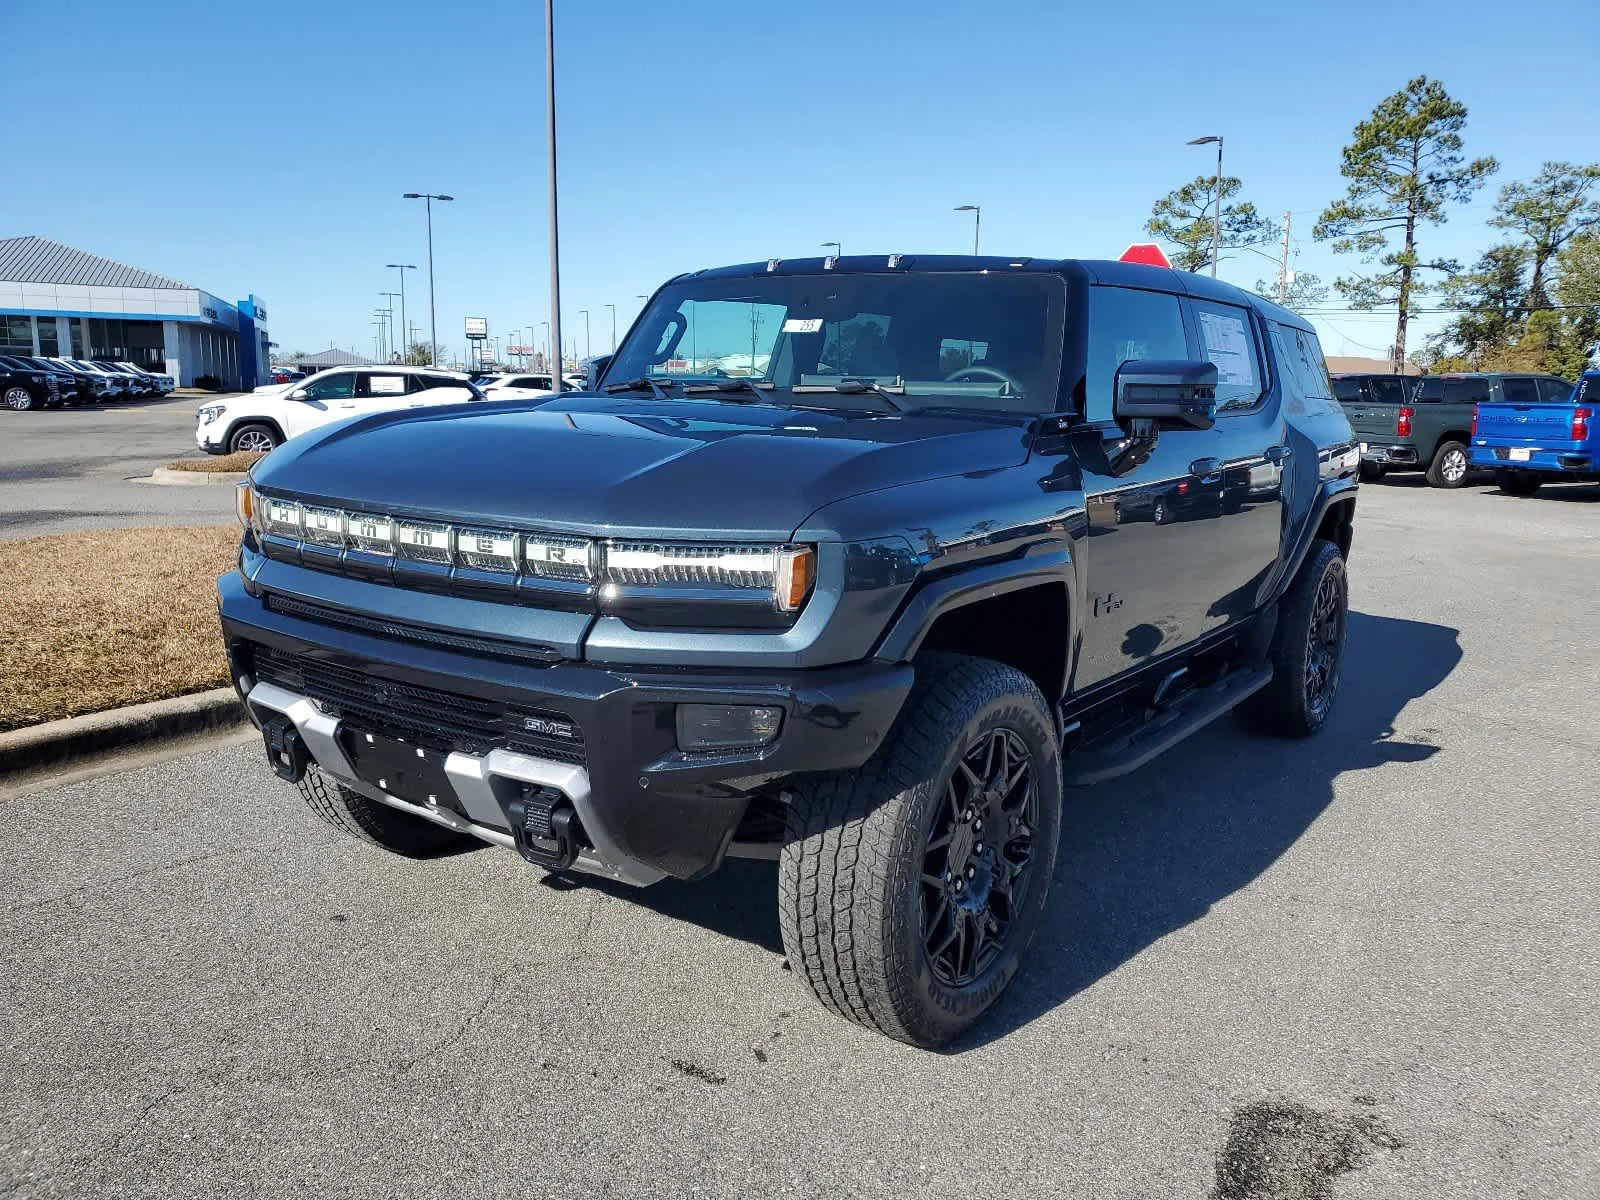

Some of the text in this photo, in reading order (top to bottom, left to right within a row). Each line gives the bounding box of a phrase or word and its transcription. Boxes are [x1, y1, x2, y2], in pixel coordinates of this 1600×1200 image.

[1481, 415, 1565, 424] CHEVOLET
[279, 510, 567, 562] HUMMER
[523, 717, 572, 737] GMC
